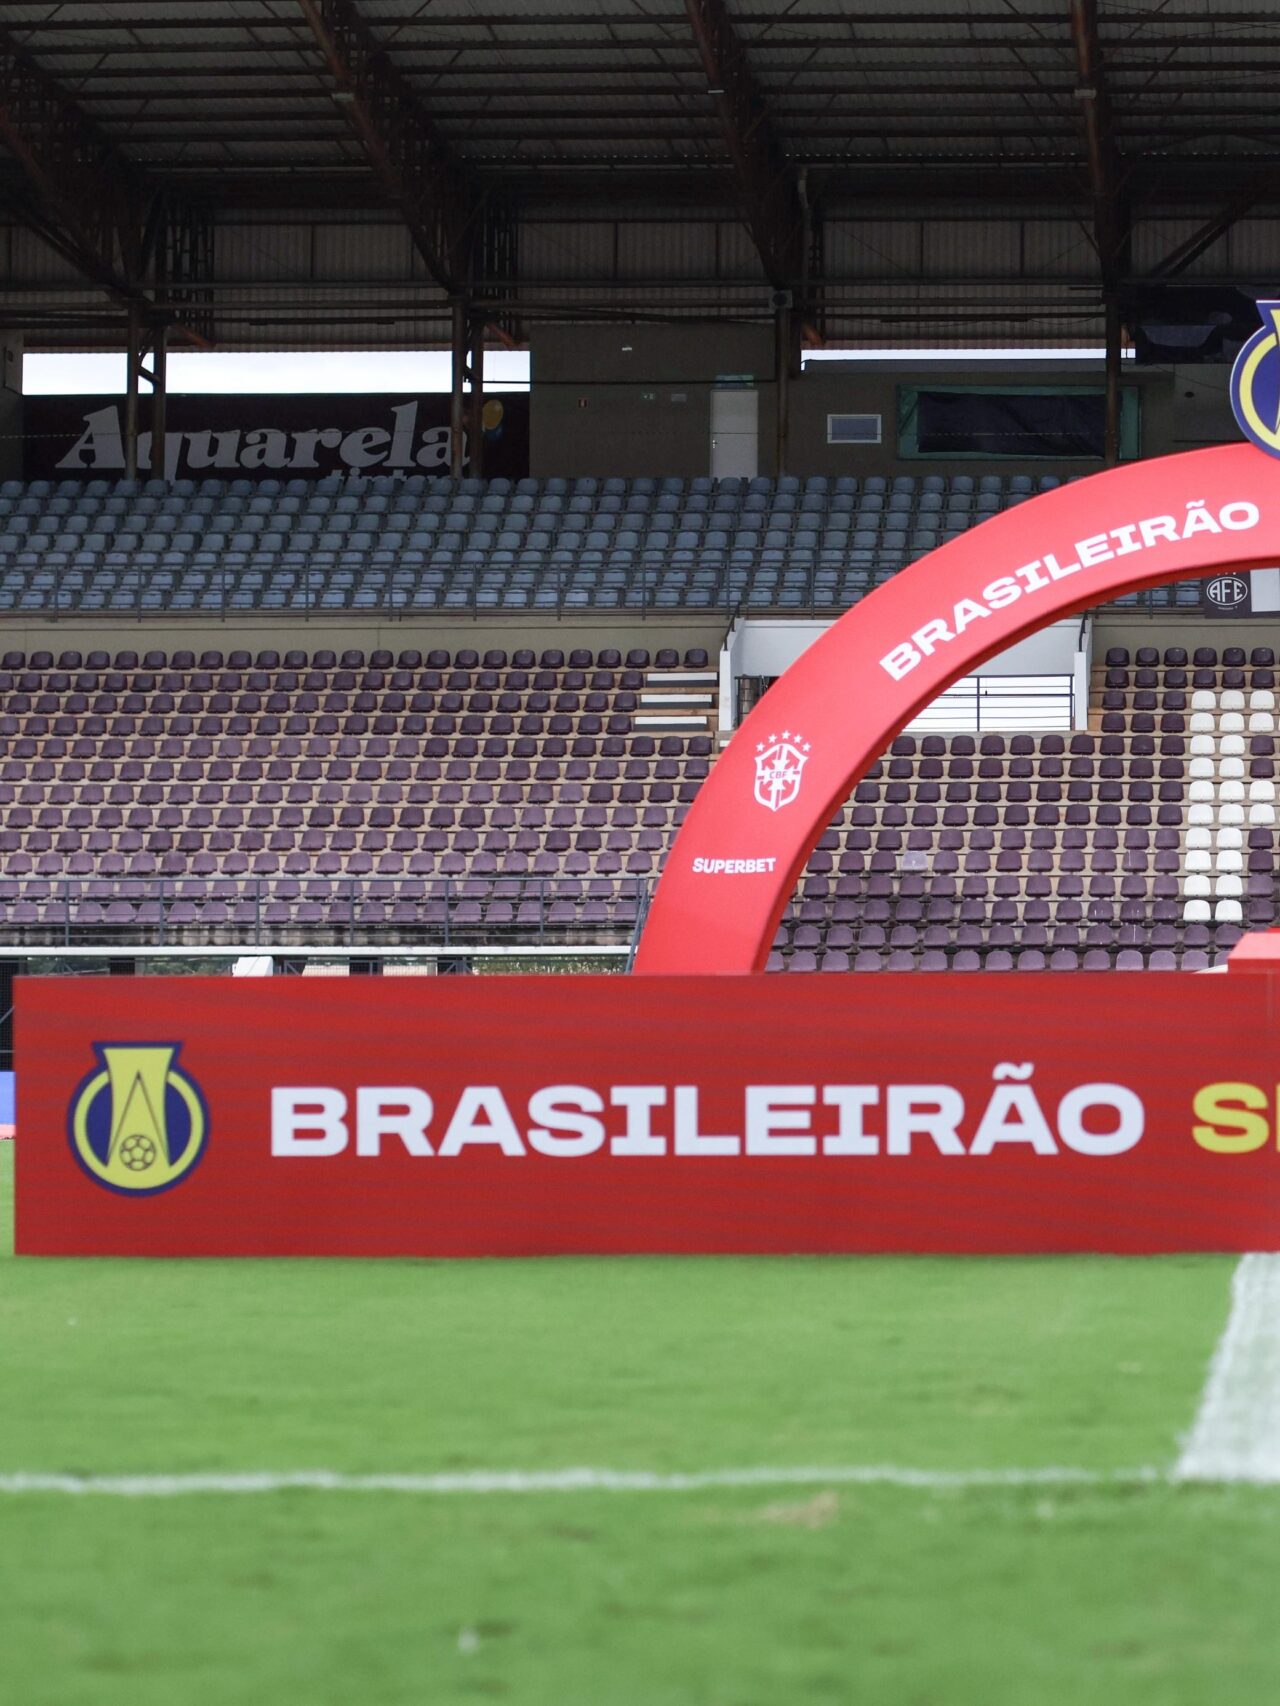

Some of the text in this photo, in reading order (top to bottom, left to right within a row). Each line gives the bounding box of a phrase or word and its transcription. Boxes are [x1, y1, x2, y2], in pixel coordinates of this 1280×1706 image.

[879, 499, 1260, 681] BRASILEIRÃO
[1210, 580, 1243, 602] AFE
[769, 771, 788, 779] CBF
[692, 857, 776, 874] SUPERBET
[271, 1063, 1145, 1156] BRASILEIRÃO
